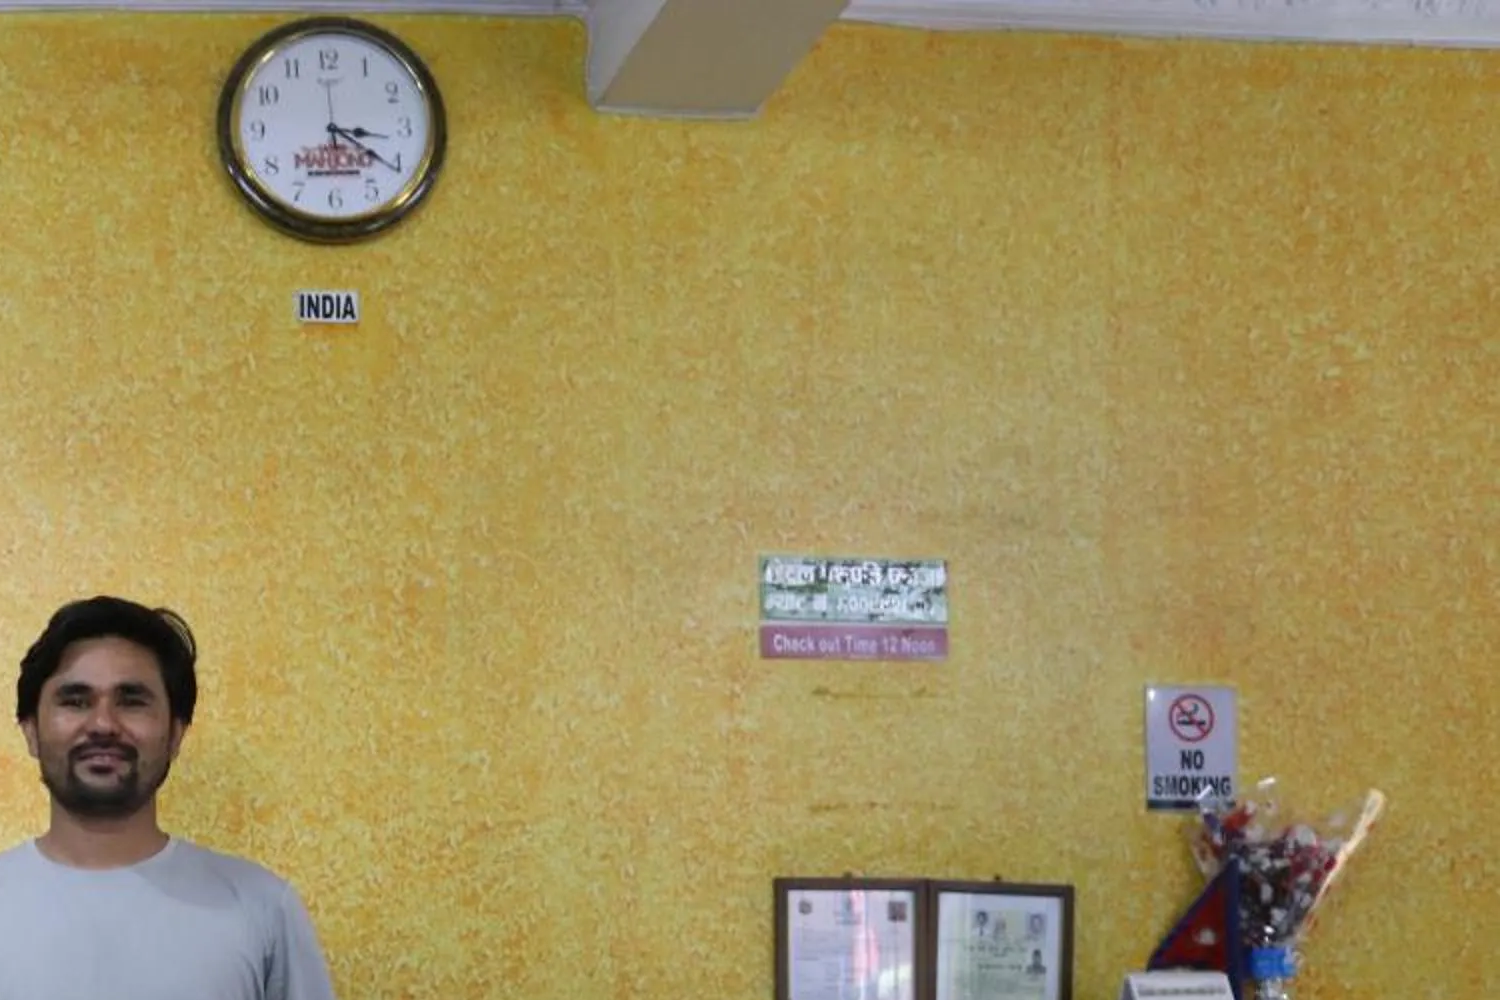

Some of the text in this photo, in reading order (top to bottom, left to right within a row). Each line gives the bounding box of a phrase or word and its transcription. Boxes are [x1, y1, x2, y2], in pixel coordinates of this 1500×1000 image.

[284, 59, 300, 79] 11
[318, 49, 339, 71] 12
[258, 86, 279, 106] 10
[385, 82, 399, 104] 2
[250, 120, 265, 141] 9
[398, 118, 413, 138] 3
[264, 156, 280, 176] 8
[291, 181, 306, 202] 7
[328, 188, 344, 210] 6
[364, 179, 379, 201] 5
[300, 294, 356, 319] INDIA
[773, 634, 936, 654] Check out Time 12 Noon
[1181, 749, 1205, 770] NO
[1153, 775, 1232, 797] SMOKING
